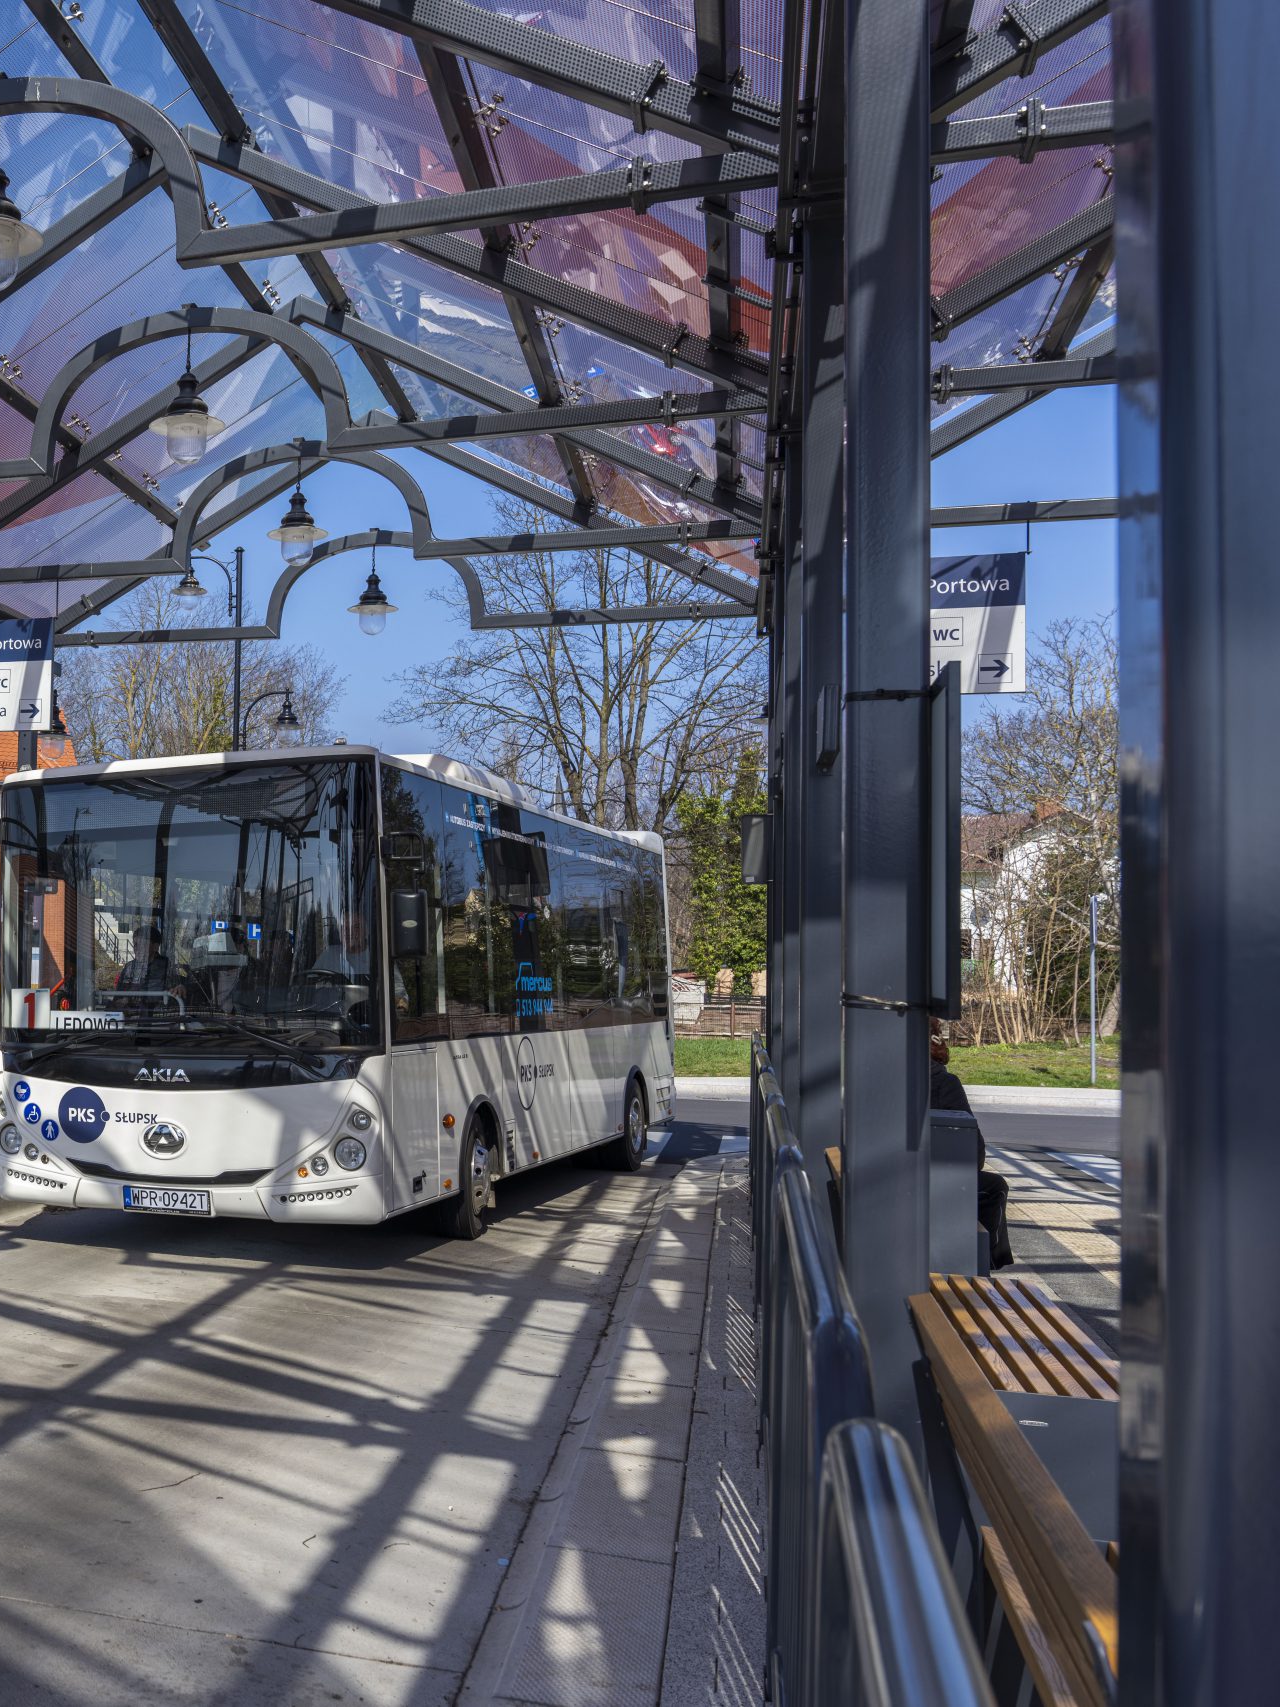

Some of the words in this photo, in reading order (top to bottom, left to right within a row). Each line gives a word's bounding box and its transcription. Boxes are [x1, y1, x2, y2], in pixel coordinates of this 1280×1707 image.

[933, 628, 960, 641] WC
[23, 992, 36, 1030] 1
[134, 1067, 191, 1083] AKIA
[520, 1064, 532, 1083] PKS
[68, 1107, 96, 1123] PKS
[115, 1111, 159, 1125] SŁUPSK
[131, 1189, 158, 1207] WPR
[162, 1191, 206, 1210] 0942T
